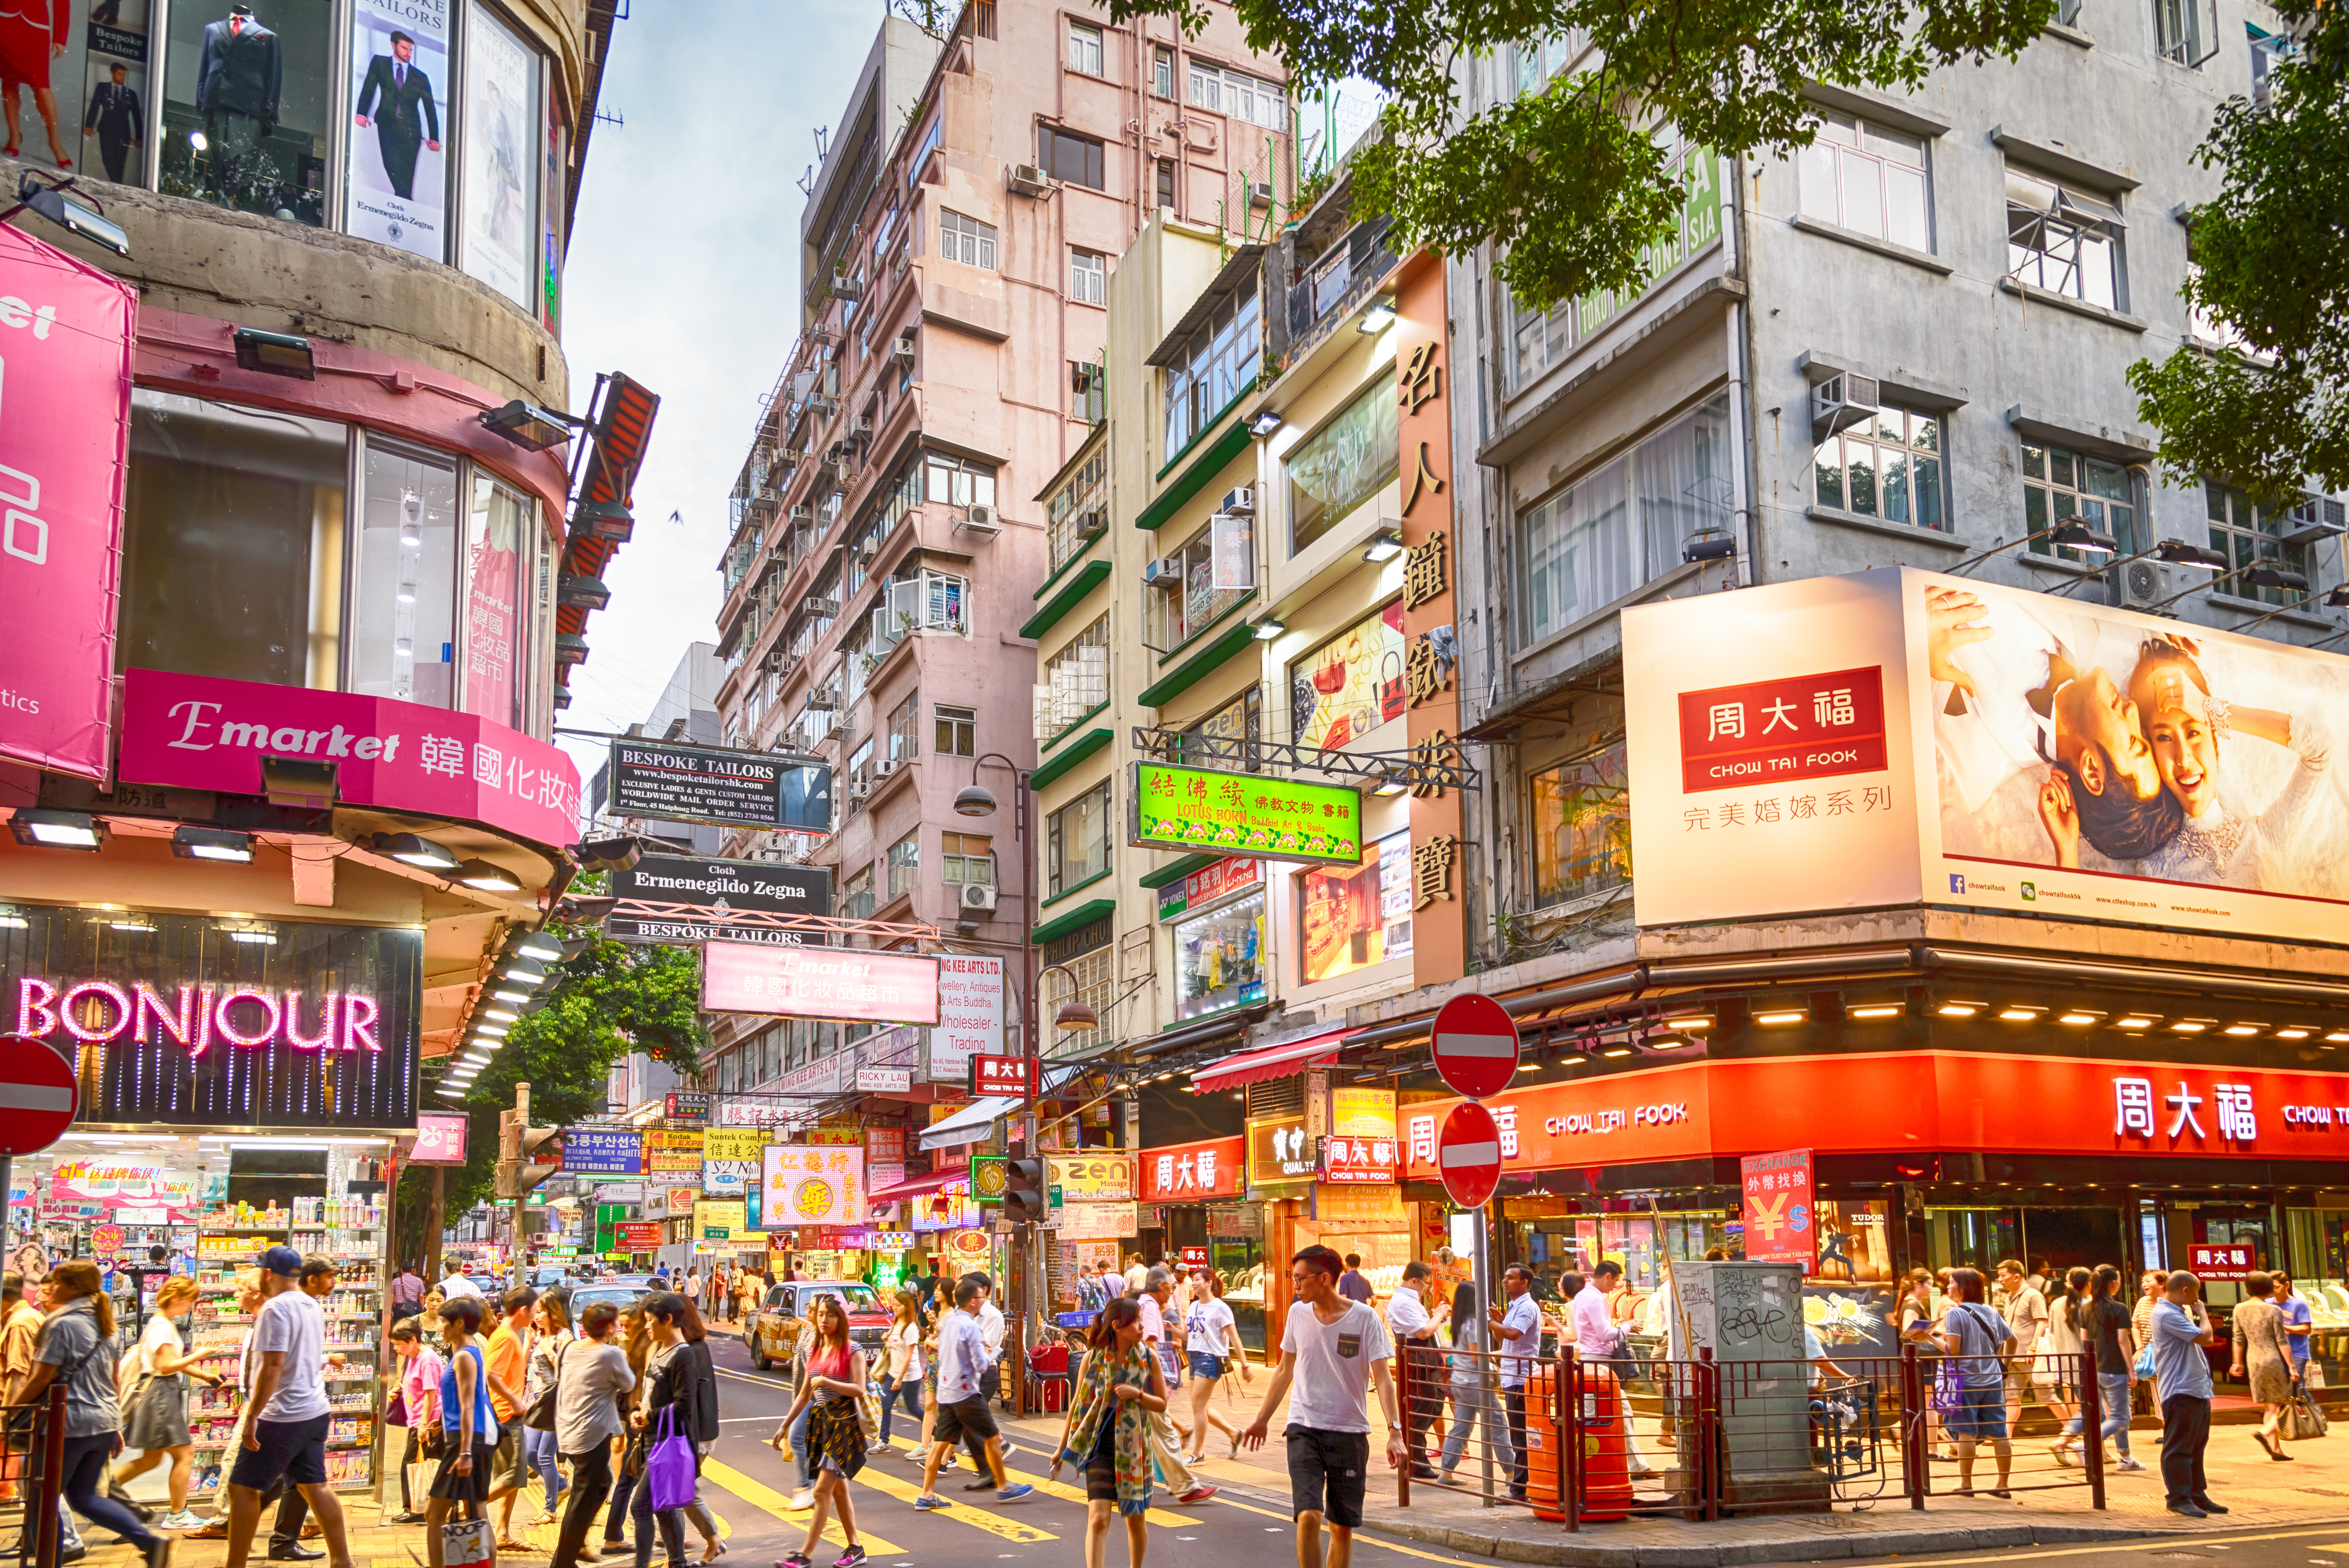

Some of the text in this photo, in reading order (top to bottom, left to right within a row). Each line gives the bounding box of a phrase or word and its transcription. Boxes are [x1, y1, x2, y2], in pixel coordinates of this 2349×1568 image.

[96, 27, 143, 46] Bespoke
[99, 39, 139, 56] Tailors
[356, 200, 434, 231] Ermenegildo Zegna
[387, 201, 405, 212] Cloth
[1581, 289, 1608, 334] TOKO
[1224, 530, 1243, 572] 泰拳
[1188, 589, 1223, 618] 3480 0629
[472, 604, 503, 637] 韓國
[471, 651, 503, 682] 超市
[1305, 624, 1385, 745] VIP GROUP
[1207, 703, 1244, 738] zen
[1708, 688, 1855, 742] 周大福
[167, 699, 401, 763] Emarket
[621, 749, 775, 780] BESPOKE TAILORS
[1709, 749, 1857, 779] CHOW TAI FOOK
[633, 768, 763, 790] www.bespoketailorshk.com
[621, 779, 659, 790] EXCLUSIVE
[661, 783, 685, 793] LADIES
[695, 788, 716, 796] GENTS
[718, 790, 745, 799] CUSTOM
[747, 793, 774, 803] TAILORS
[621, 788, 774, 812] WORLDWIDE MAIL ORDER SERVICE
[1149, 772, 1246, 809] 結佛緣
[1255, 796, 1314, 815] 佛教文物
[629, 800, 648, 809] Floor,
[658, 803, 690, 814] Haiphong
[691, 806, 710, 815] Road.
[727, 810, 743, 819] (852)
[1177, 803, 1325, 833] LOTUS BORN Buddhist Art & Books
[1684, 784, 1892, 832] 完美婚嫁系列
[708, 865, 736, 876] Cloth
[1200, 866, 1221, 891] 銘羽
[1227, 869, 1254, 887] LI-NING
[634, 871, 806, 900] Ermenegildo Zegna
[1968, 880, 2006, 892] chowtaifook
[2038, 888, 2082, 901] chowtaifookhk
[1169, 890, 1186, 906] YONEX
[1189, 886, 1223, 907] HIPPO SPORTS
[2095, 896, 2158, 909] www.ctfeshop.com.hk
[2170, 904, 2232, 917] www.chowtaifook.com
[637, 923, 802, 945] BESPOKE TAILORS
[778, 952, 871, 978] Emarket
[953, 960, 966, 973] KEE
[967, 960, 985, 974] ARTS
[986, 961, 1001, 975] LTD.
[743, 974, 900, 1004] 韓國化妝品超市
[941, 980, 1001, 995] wellery, Antiques
[778, 998, 797, 1007] Korea
[799, 1000, 827, 1008] Skincare
[835, 1002, 870, 1011] Cosmetics
[947, 996, 962, 1007] Arts
[964, 997, 994, 1008] Buddha.
[18, 977, 385, 1059] BONJOUR
[948, 1035, 985, 1054] Trading
[780, 1075, 795, 1091] WING
[796, 1069, 808, 1086] KEE
[808, 1062, 824, 1081] ARTS
[825, 1057, 839, 1074] LTD.
[859, 1072, 908, 1082] RICKY LAU
[1337, 1092, 1393, 1105] 結佛緣書店
[2112, 1076, 2257, 1140] 周大福
[1545, 1102, 1687, 1136] CHOW TAI FOOK
[2284, 1105, 2331, 1124] CHOW
[446, 1122, 460, 1156] 卡萊美
[870, 1131, 902, 1143] 勝記五金
[870, 1144, 902, 1155] 漆油電器
[1331, 1141, 1390, 1163] 周大福
[59, 1163, 85, 1180] 第1浪
[737, 1160, 759, 1175] Nail
[779, 1150, 850, 1173] 仁德行
[978, 1160, 1004, 1170] FOOT SPA
[1068, 1162, 1128, 1179] zen
[1157, 1151, 1217, 1192] 周大福
[1744, 1154, 1807, 1174] EXCHANGE
[1748, 1170, 1806, 1192] 外幣找換
[1117, 1213, 1134, 1232] $80
[97, 1227, 123, 1241] Sale
[1094, 1244, 1116, 1257] 銘羽
[2197, 1250, 2246, 1265] 周大福
[1432, 1263, 1471, 1277] Jenny Bakery
